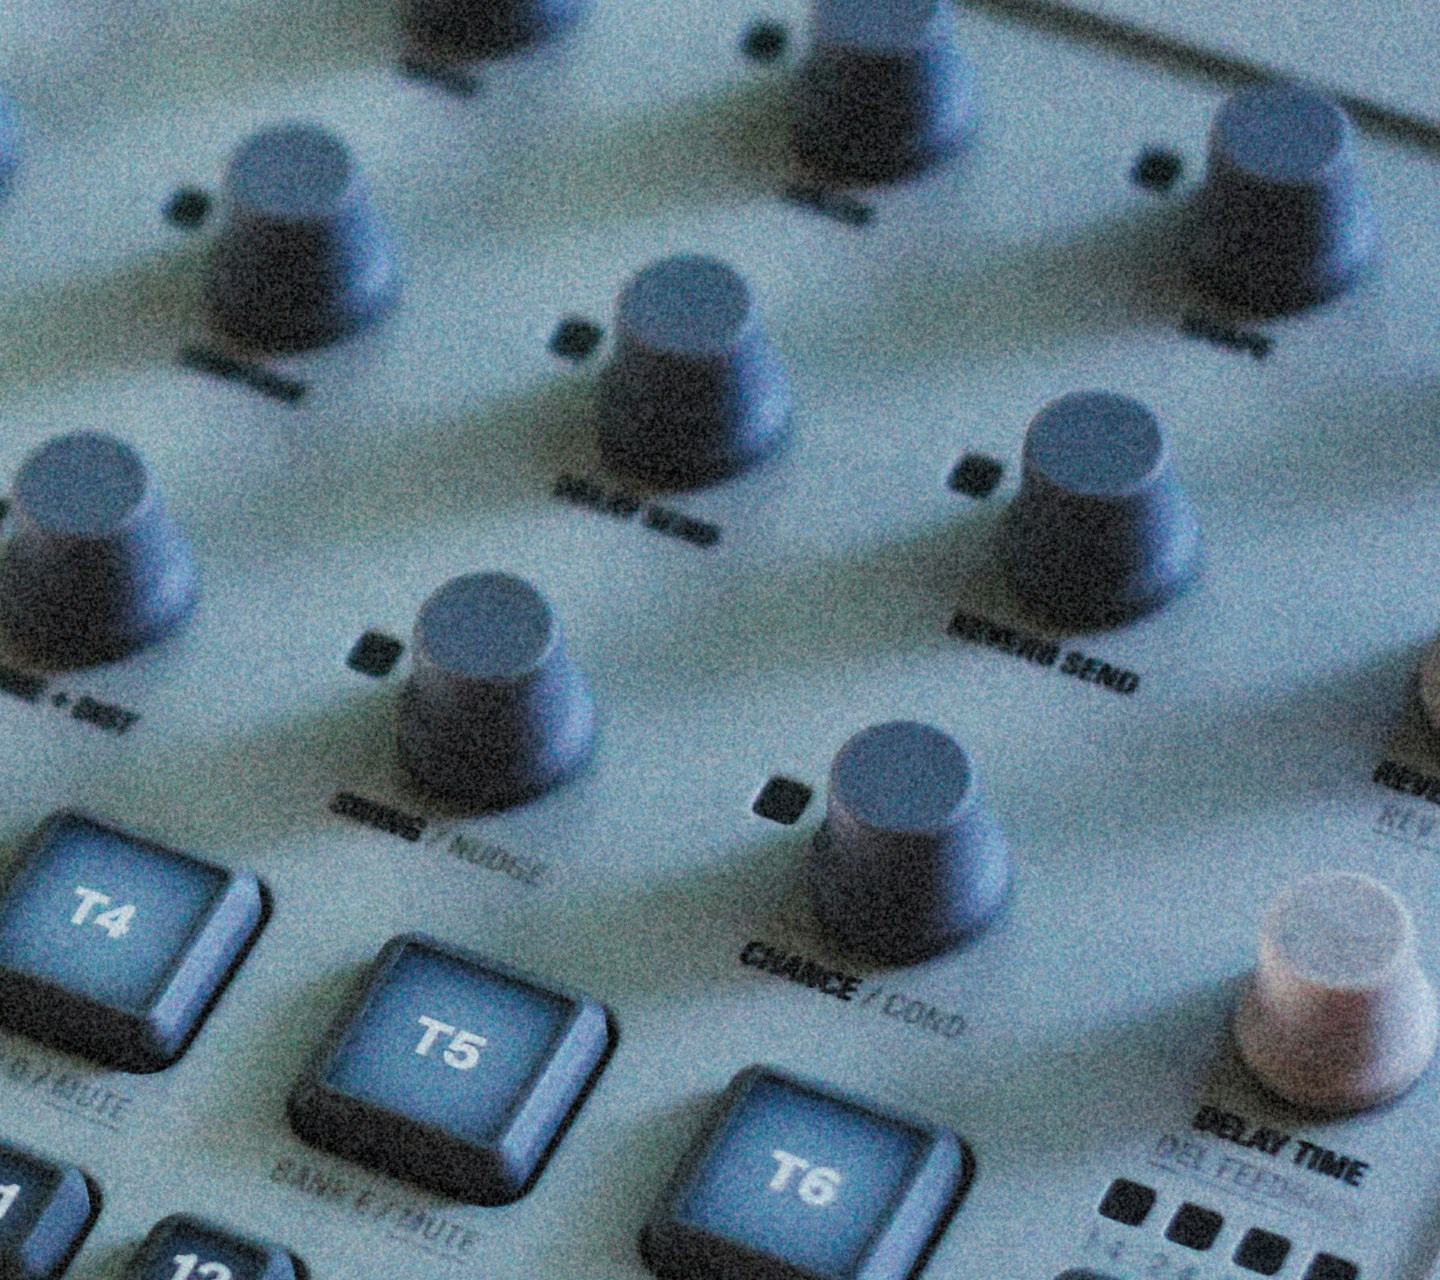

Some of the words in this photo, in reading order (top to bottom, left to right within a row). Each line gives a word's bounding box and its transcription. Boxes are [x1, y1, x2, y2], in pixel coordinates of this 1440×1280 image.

[1061, 650, 1141, 696] SEND
[70, 885, 138, 940] T4
[740, 940, 863, 1002] CHANCE
[883, 992, 968, 1040] COND
[414, 1014, 488, 1071] T5
[1156, 1133, 1207, 1172] DEL
[1192, 1105, 1293, 1158] DELAY
[1293, 1139, 1371, 1189] TIME
[768, 1148, 843, 1208] T6
